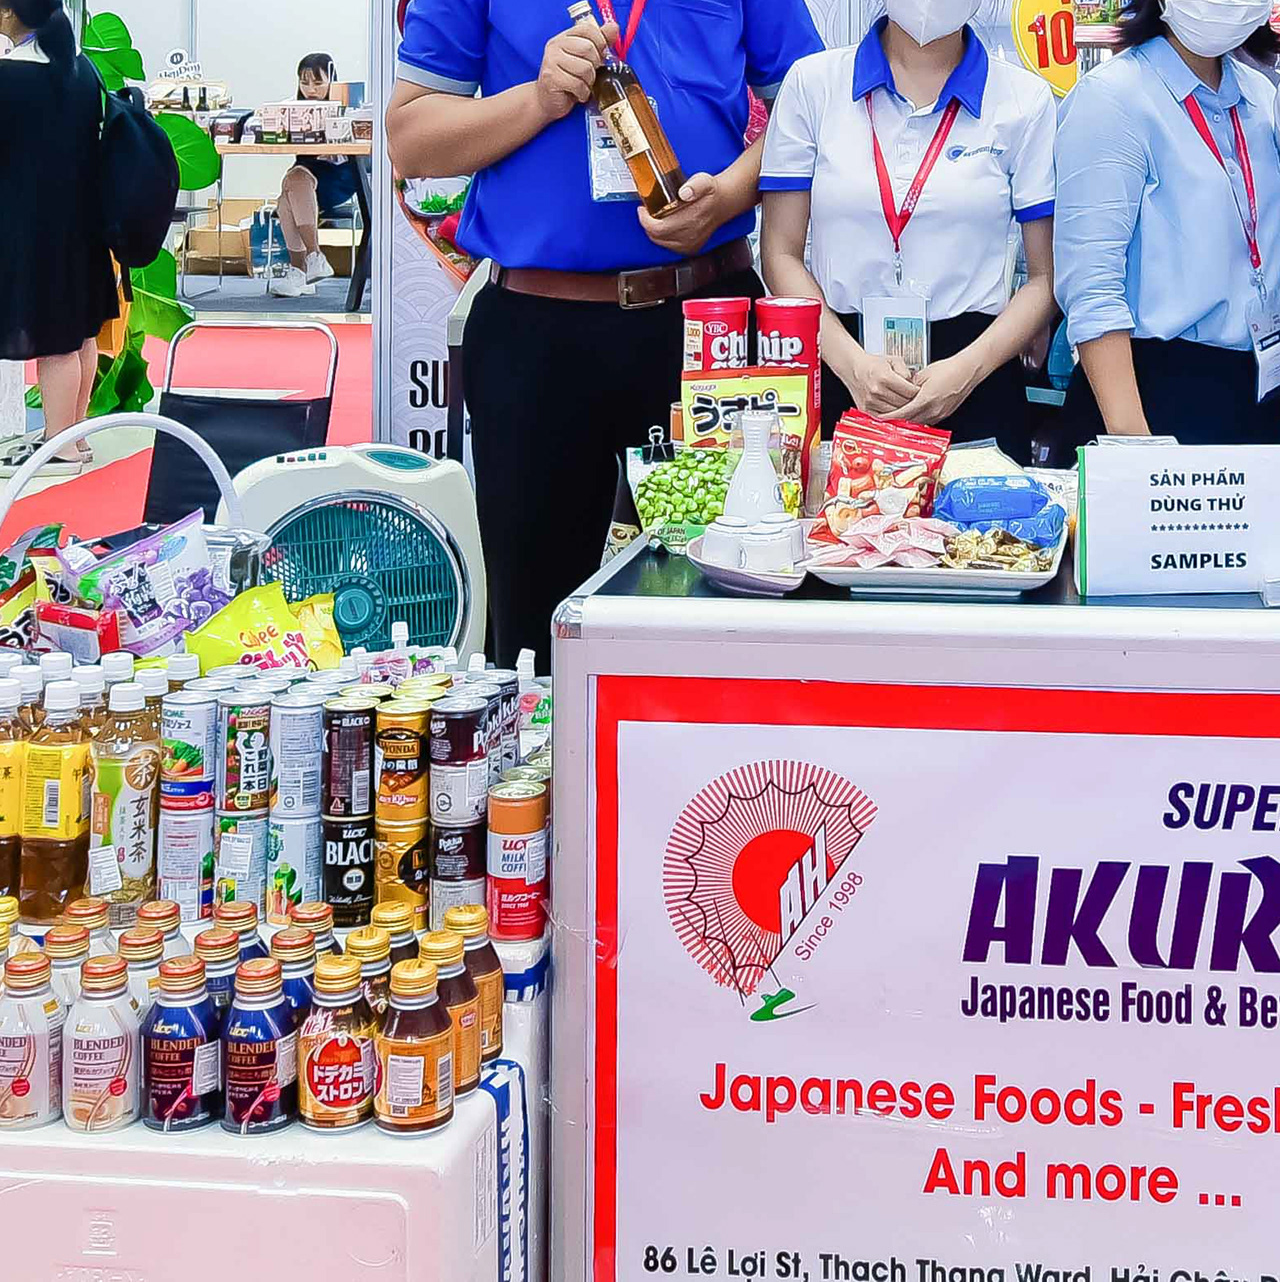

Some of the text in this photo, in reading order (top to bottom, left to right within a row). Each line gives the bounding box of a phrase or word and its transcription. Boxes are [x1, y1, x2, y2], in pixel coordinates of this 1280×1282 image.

[1150, 467, 1245, 488] SẢN PHẨM
[1150, 494, 1246, 514] DÙNG THỬ
[1151, 551, 1247, 572] SAMPLES
[382, 741, 419, 755] WONDA
[129, 795, 149, 865] 玄米茶
[795, 872, 863, 961] Since 1998
[961, 975, 1110, 1025] Japanese
[1121, 982, 1193, 1025] Food
[1206, 985, 1227, 1026] &
[73, 1036, 125, 1049] BLENDED
[700, 1062, 955, 1122] Japanese
[973, 1079, 1124, 1126] Foods
[924, 1151, 1180, 1205] And more
[643, 1246, 677, 1273] 86
[687, 1247, 718, 1275] Lê
[728, 1249, 766, 1282] Lợi
[776, 1251, 810, 1282] St,
